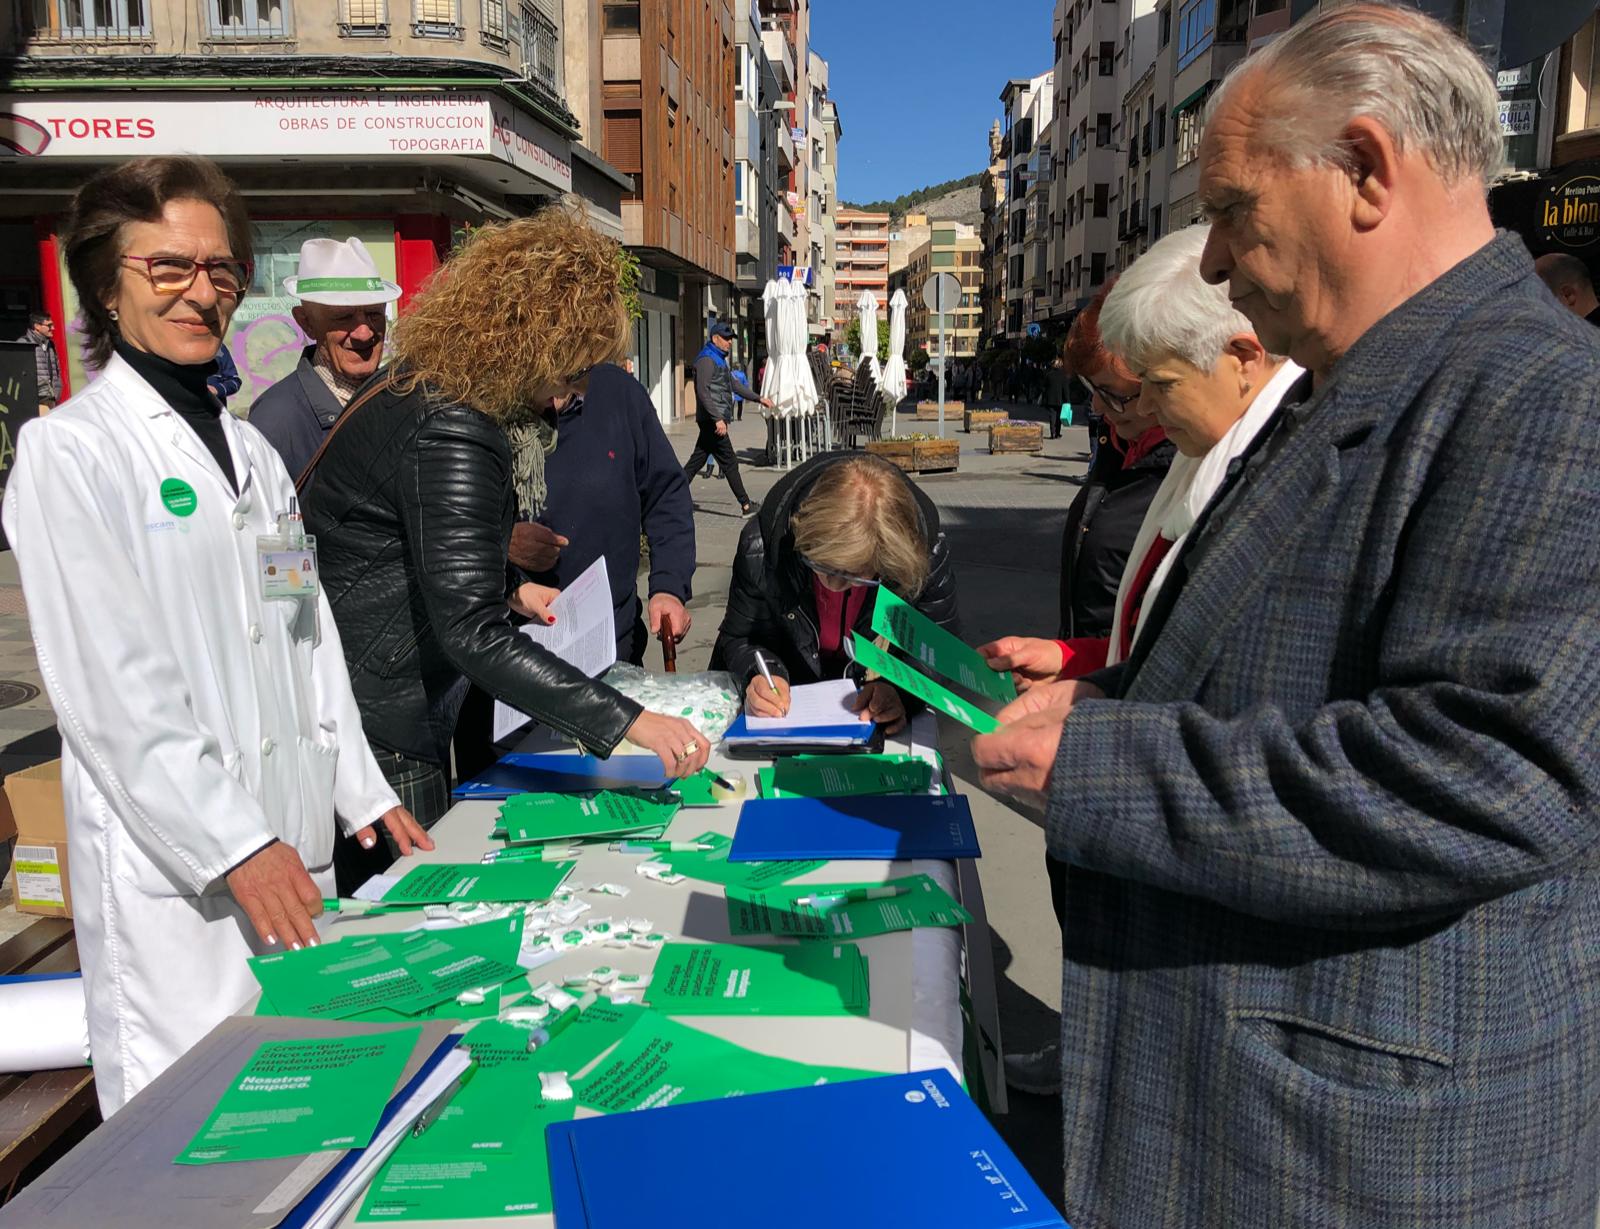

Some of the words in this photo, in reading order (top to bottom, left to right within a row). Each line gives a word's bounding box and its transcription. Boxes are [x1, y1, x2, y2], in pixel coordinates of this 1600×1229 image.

[254, 95, 370, 111] ARQUITECTURA
[377, 96, 385, 107] E
[394, 94, 484, 107] INGENIERIA
[48, 118, 155, 139] TORES
[279, 117, 329, 130] OBRAS
[337, 118, 357, 129] DE
[364, 116, 484, 129] CONSTRUCCION
[389, 138, 485, 151] TOPOGRAFIA
[515, 135, 570, 179] CONSULTORES
[1543, 200, 1559, 226] la
[238, 1082, 310, 1092] tampoco.
[242, 1075, 312, 1085] Nosotros
